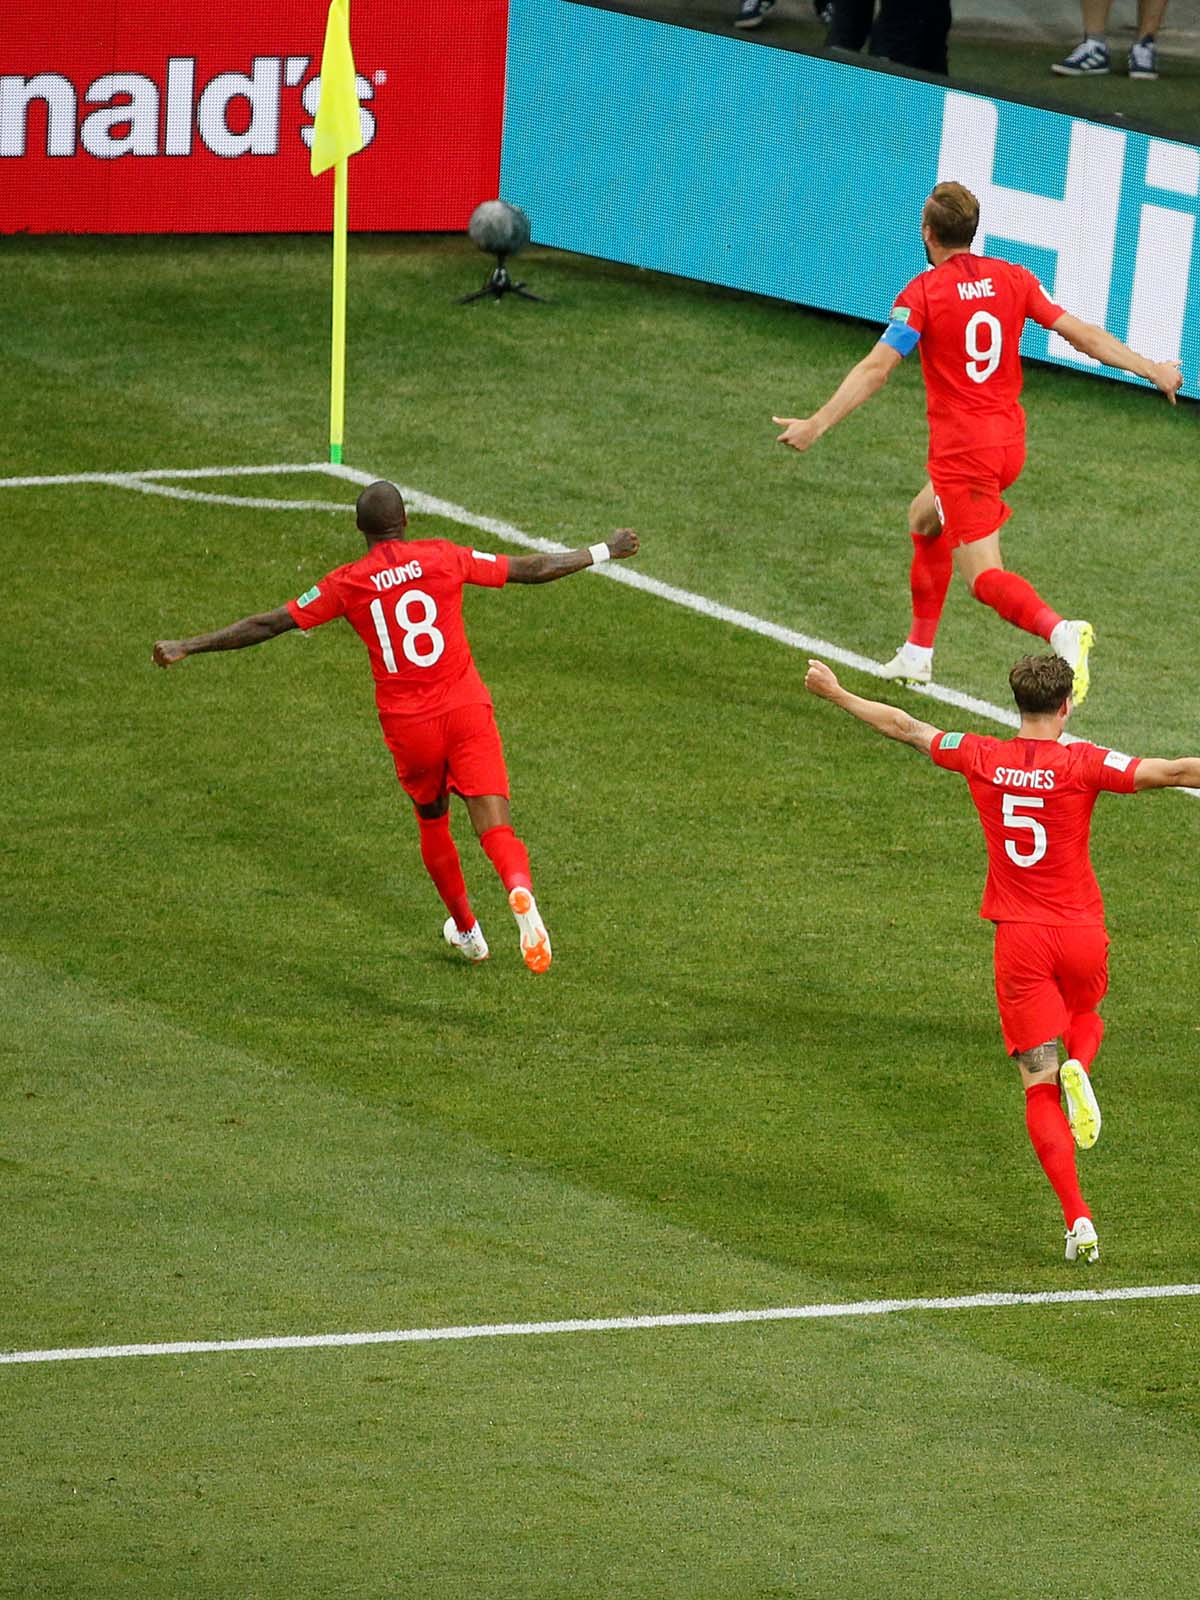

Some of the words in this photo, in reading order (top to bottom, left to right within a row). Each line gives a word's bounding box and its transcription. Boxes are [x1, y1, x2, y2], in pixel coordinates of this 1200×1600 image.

[957, 277, 996, 301] KANE
[965, 310, 1002, 384] 9
[370, 560, 423, 591] YOUNG
[369, 588, 445, 674] 18
[992, 766, 1055, 790] STONES
[1002, 792, 1048, 868] 5
